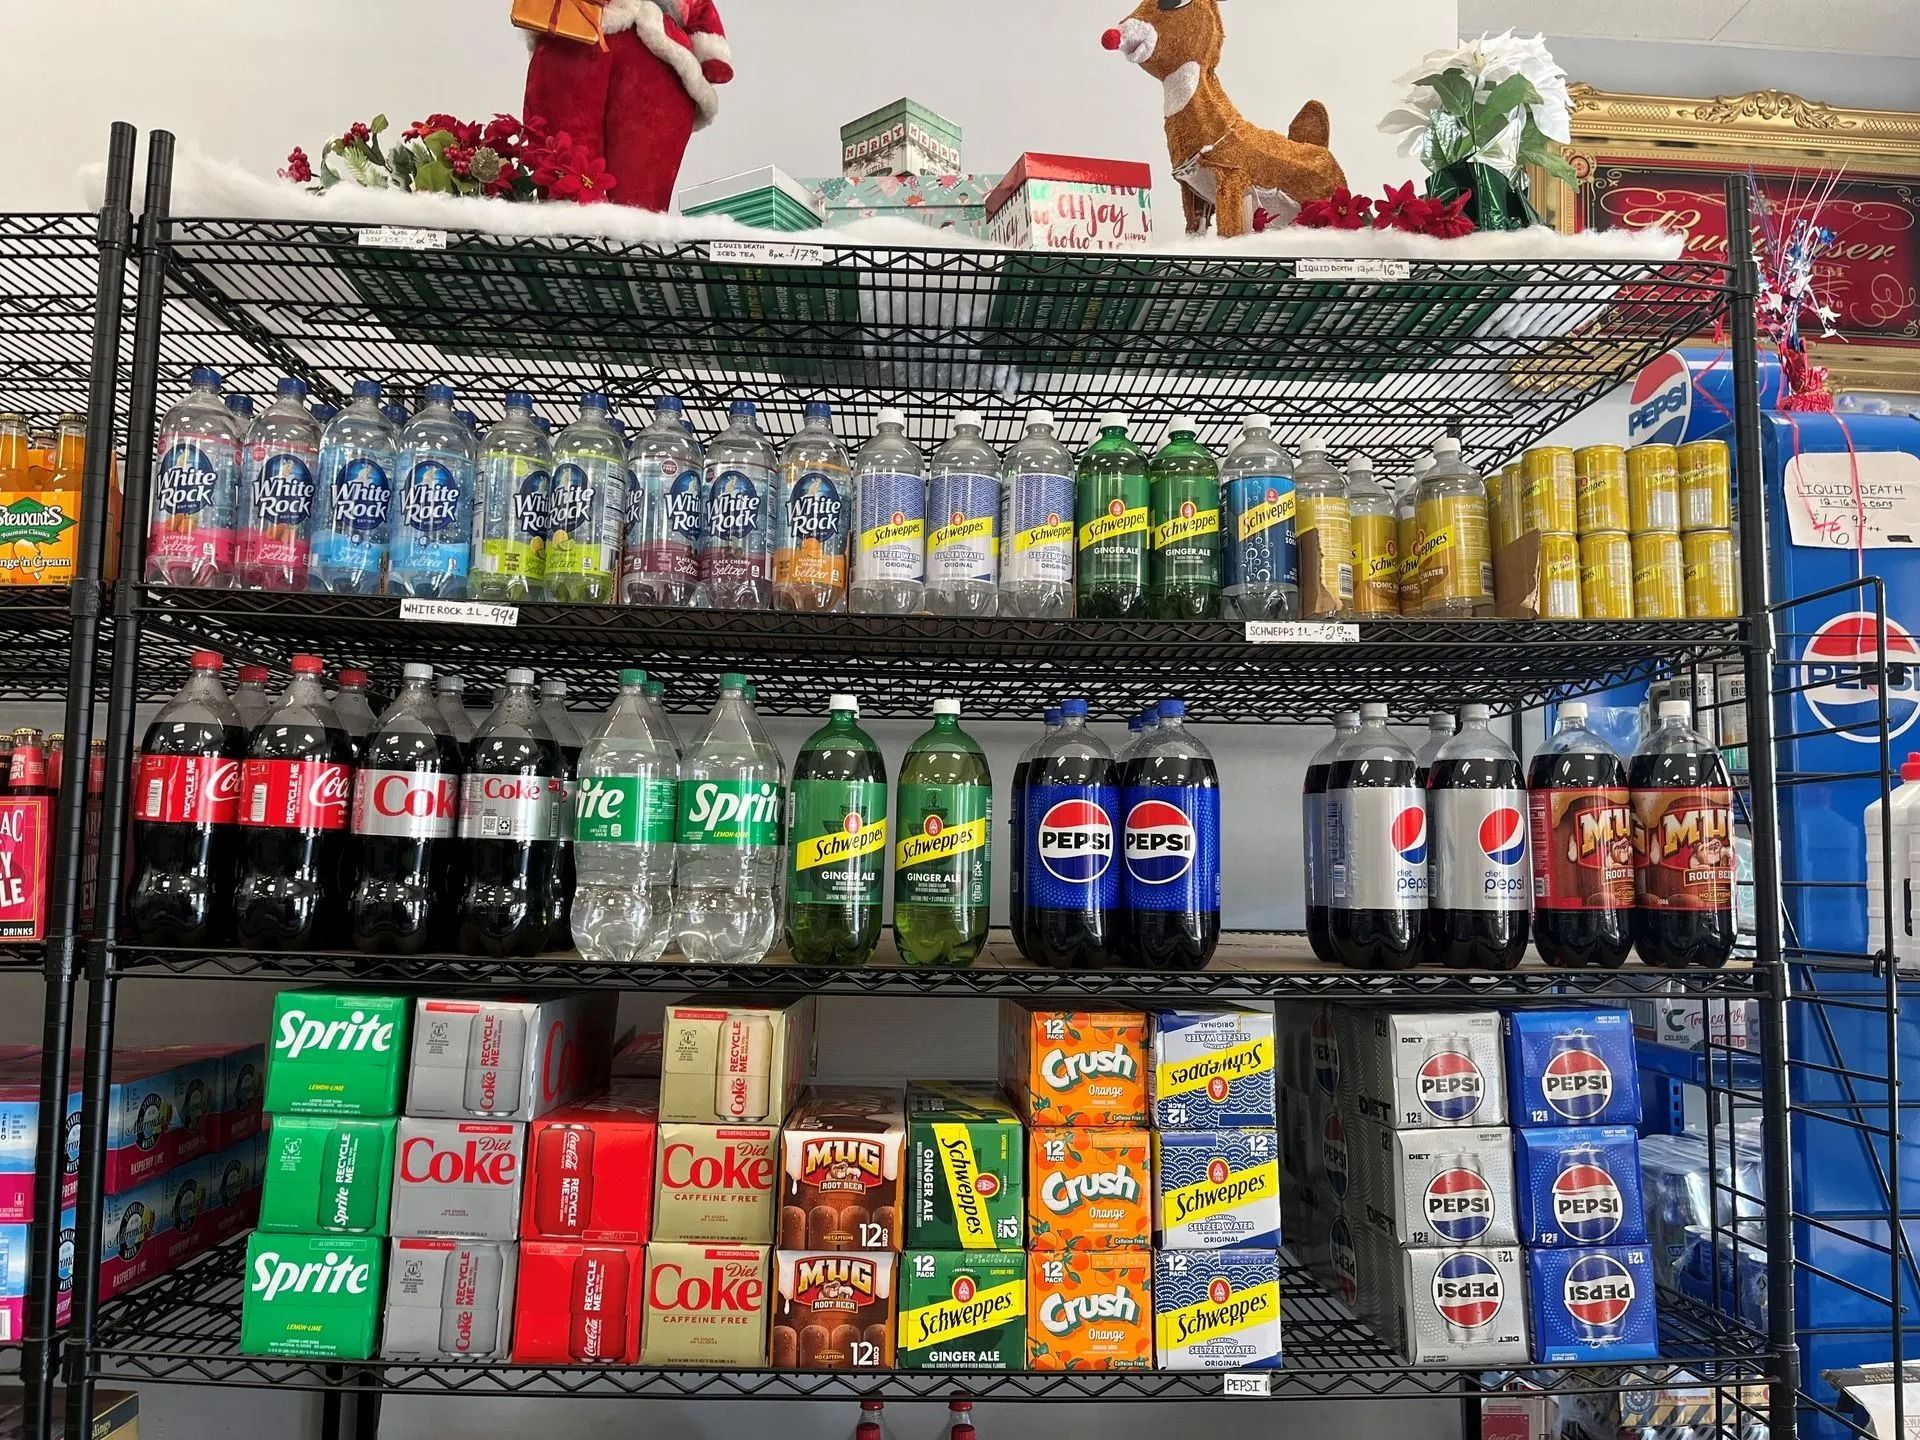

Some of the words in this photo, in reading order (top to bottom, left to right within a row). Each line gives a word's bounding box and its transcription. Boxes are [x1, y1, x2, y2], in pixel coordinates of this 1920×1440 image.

[846, 127, 902, 158] MERRY
[911, 127, 958, 161] MERRY
[716, 250, 737, 258] ICED
[1298, 264, 1329, 272] LIQUID
[1331, 264, 1353, 272] DEATH
[1628, 381, 1687, 437] PEPSI
[157, 467, 217, 498] White
[252, 477, 315, 506] White
[1796, 484, 1853, 495] LIQUID
[1860, 485, 1904, 495] DEATH
[160, 486, 213, 511] Rock
[332, 481, 391, 509] White
[400, 484, 460, 514] White
[1869, 500, 1893, 508] cans
[259, 497, 311, 518] Rock
[337, 501, 387, 521] Rock
[405, 502, 456, 525] Rock
[707, 493, 760, 523] White
[787, 496, 841, 526] White
[1243, 498, 1295, 535] Schweppes
[711, 510, 757, 535] Rock
[791, 513, 839, 537] Rock
[1088, 512, 1145, 542] Schweppes
[1160, 514, 1216, 543] Schweppes
[874, 523, 920, 544] Schweppes
[1030, 526, 1072, 545] Schweppes
[159, 540, 198, 552] Seltzer
[1094, 546, 1124, 555] GINGER
[1126, 546, 1139, 555] ALE
[1166, 548, 1196, 556] GINGER
[1198, 548, 1211, 556] ALE
[712, 564, 748, 576] Seltzer
[793, 566, 829, 579] Seltzer
[885, 561, 913, 569] ORIGINAL
[1424, 567, 1444, 579] WATER
[1250, 626, 1294, 636] SCHWEPPS
[187, 758, 197, 773] ME
[290, 763, 300, 780] ME
[183, 773, 195, 819] RECYCLE
[484, 777, 541, 801] Coke
[286, 780, 298, 824] RECYCLE
[814, 826, 884, 862] Schweppes
[902, 828, 973, 864] Schweppes
[1042, 831, 1111, 850] PEPSI
[1126, 832, 1192, 852] PEPSI
[821, 871, 859, 881] GINGER
[862, 871, 876, 881] ALE
[907, 872, 942, 882] GINGER
[944, 873, 961, 883] ALE
[1397, 869, 1412, 877] diet
[1485, 869, 1502, 878] diet
[1605, 870, 1626, 880] ROOT
[1485, 876, 1525, 893] pepsi
[3, 928, 34, 936] DRINKS
[275, 1010, 394, 1058] Sprite
[1044, 1019, 1064, 1034] 12
[481, 1015, 495, 1067] RECYCLE
[1185, 1034, 1216, 1042] WATER
[1217, 1033, 1251, 1042] SELTZER
[730, 1021, 742, 1073] RECYCLE
[490, 1049, 499, 1067] ME
[738, 1055, 748, 1073] ME
[1042, 1044, 1136, 1090] Crush
[1169, 1044, 1263, 1086] Schweppes
[308, 1083, 345, 1092] LEMON-LIME
[480, 1072, 496, 1111] Coke
[1088, 1085, 1123, 1097] Orange
[1422, 1077, 1480, 1094] PEPSI
[1547, 1076, 1607, 1092] PEPSI
[730, 1077, 746, 1115] Coke
[479, 1136, 511, 1151] Diet
[736, 1142, 769, 1157] Diet
[1247, 1135, 1269, 1151] 12
[400, 1137, 515, 1185] Coke
[663, 1144, 774, 1189] Coke
[805, 1141, 882, 1174] MUG
[924, 1149, 934, 1196] GINGER
[822, 1182, 841, 1190] ROOT
[843, 1183, 863, 1191] BEER
[1041, 1165, 1137, 1213] Crush
[334, 1187, 349, 1226] Sprite
[568, 1178, 579, 1227] RECYCLE
[674, 1193, 727, 1202] CAFFEINE
[731, 1194, 759, 1203] FREE
[1558, 1198, 1619, 1215] PEPSI
[924, 1201, 934, 1221] ALE
[1089, 1207, 1125, 1220] Orange
[1205, 1214, 1236, 1222] SPARKLING
[1188, 1221, 1222, 1232] SELTZER
[1223, 1220, 1255, 1231] WATER
[725, 1262, 758, 1278] Diet
[913, 1255, 935, 1271] 12
[1042, 1262, 1063, 1277] 12
[1165, 1255, 1188, 1270] 12
[251, 1252, 369, 1301] Sprite
[456, 1252, 470, 1305] RECYCLE
[584, 1260, 597, 1311] RECYCLE
[797, 1260, 873, 1293] MUG
[465, 1286, 475, 1305] ME
[649, 1263, 763, 1311] Coke
[1437, 1282, 1499, 1298] PEPSI
[1569, 1283, 1631, 1300] PEPSI
[814, 1301, 833, 1310] ROOT
[835, 1302, 855, 1310] BEER
[1040, 1286, 1137, 1335] Crush
[663, 1316, 716, 1324] CAFFEINE
[720, 1316, 748, 1325] FREE
[919, 1292, 1014, 1342] Schweppes
[286, 1323, 323, 1332] LEMON-LIME
[456, 1311, 472, 1351] Coke
[1088, 1328, 1125, 1341] Orange
[584, 1317, 598, 1357] Coca-Cola
[1206, 1337, 1238, 1345] SPARKLING
[929, 1351, 971, 1362] GINGER
[975, 1351, 1000, 1362] ALE
[1189, 1345, 1223, 1354] SELTZER
[1224, 1345, 1256, 1354] WATER
[1205, 1359, 1240, 1367] ORIGINAL
[1227, 1378, 1260, 1392] PEPSI
